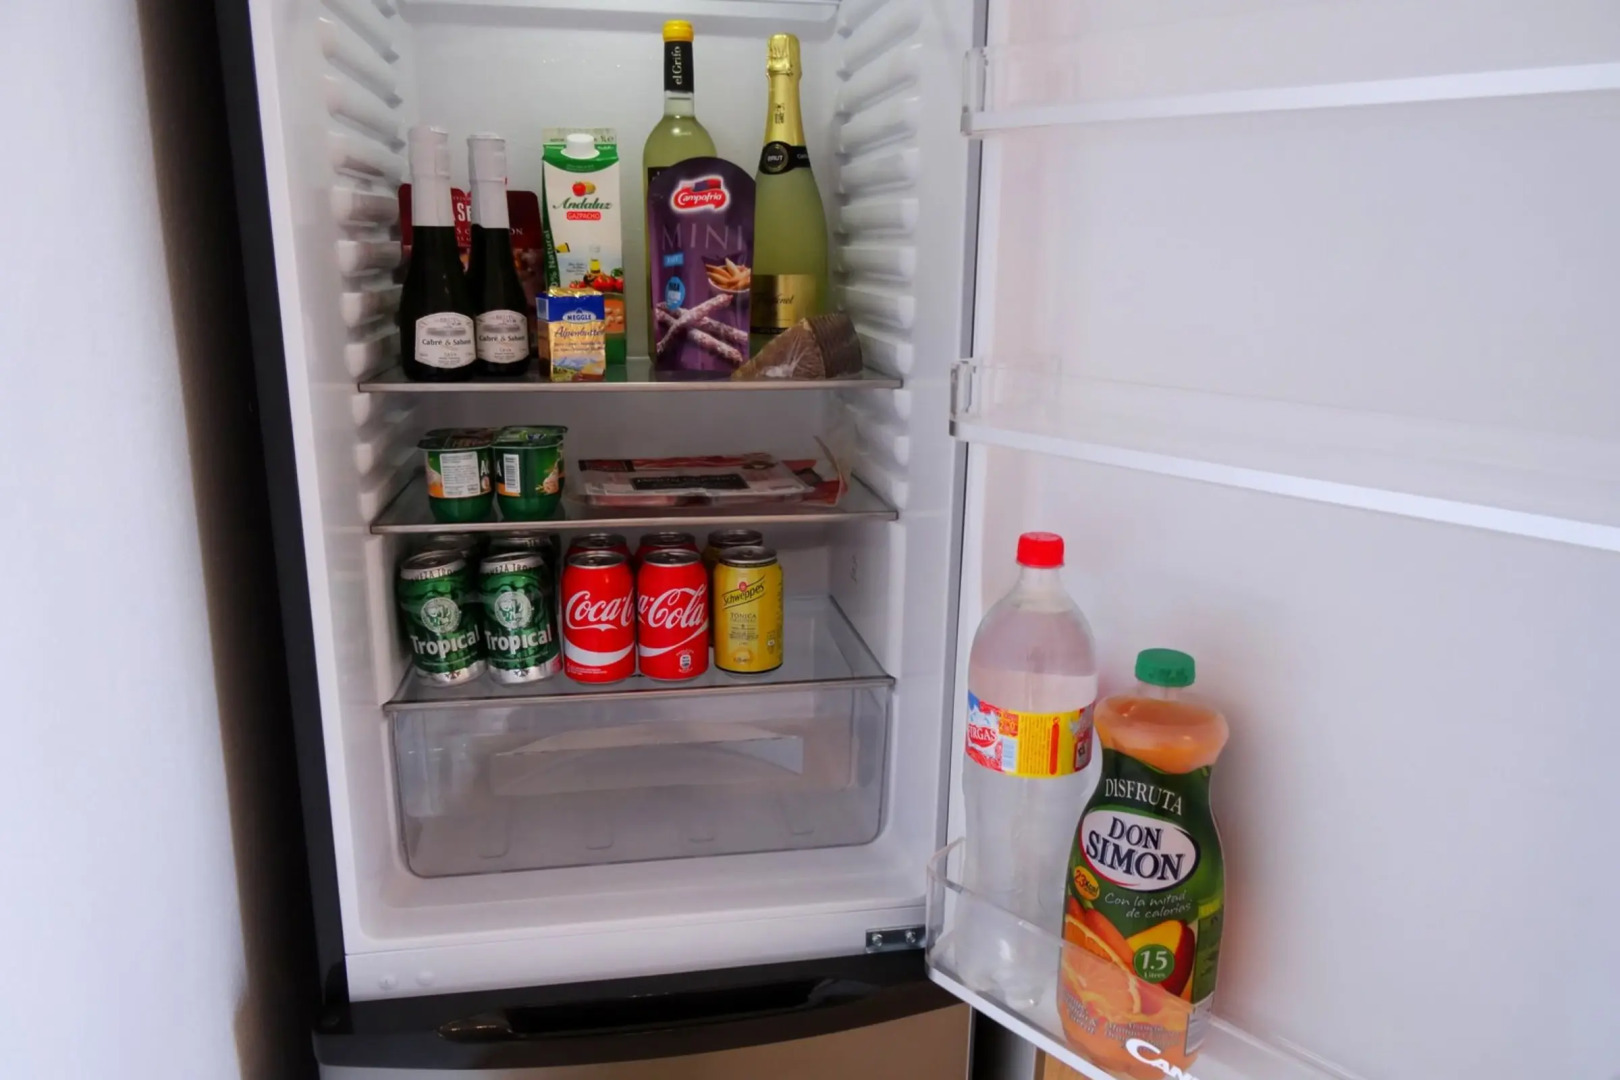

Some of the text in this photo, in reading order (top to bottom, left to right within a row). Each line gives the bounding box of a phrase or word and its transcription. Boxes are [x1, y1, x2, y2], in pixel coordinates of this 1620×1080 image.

[671, 46, 683, 85] el Grifo
[552, 197, 613, 210] Andaluz
[567, 211, 601, 220] GAZPACHO
[662, 222, 743, 250] MINI
[723, 583, 765, 606] Schweppes
[410, 624, 480, 659] Tropical
[485, 624, 552, 655] Tropical
[1105, 778, 1183, 816] DISFRUTA
[1108, 816, 1162, 851] DON
[1086, 830, 1185, 882] SIMON
[1105, 892, 1131, 906] Con
[1134, 894, 1146, 907] la
[1126, 907, 1141, 919] de
[1140, 950, 1168, 972] 1.5
